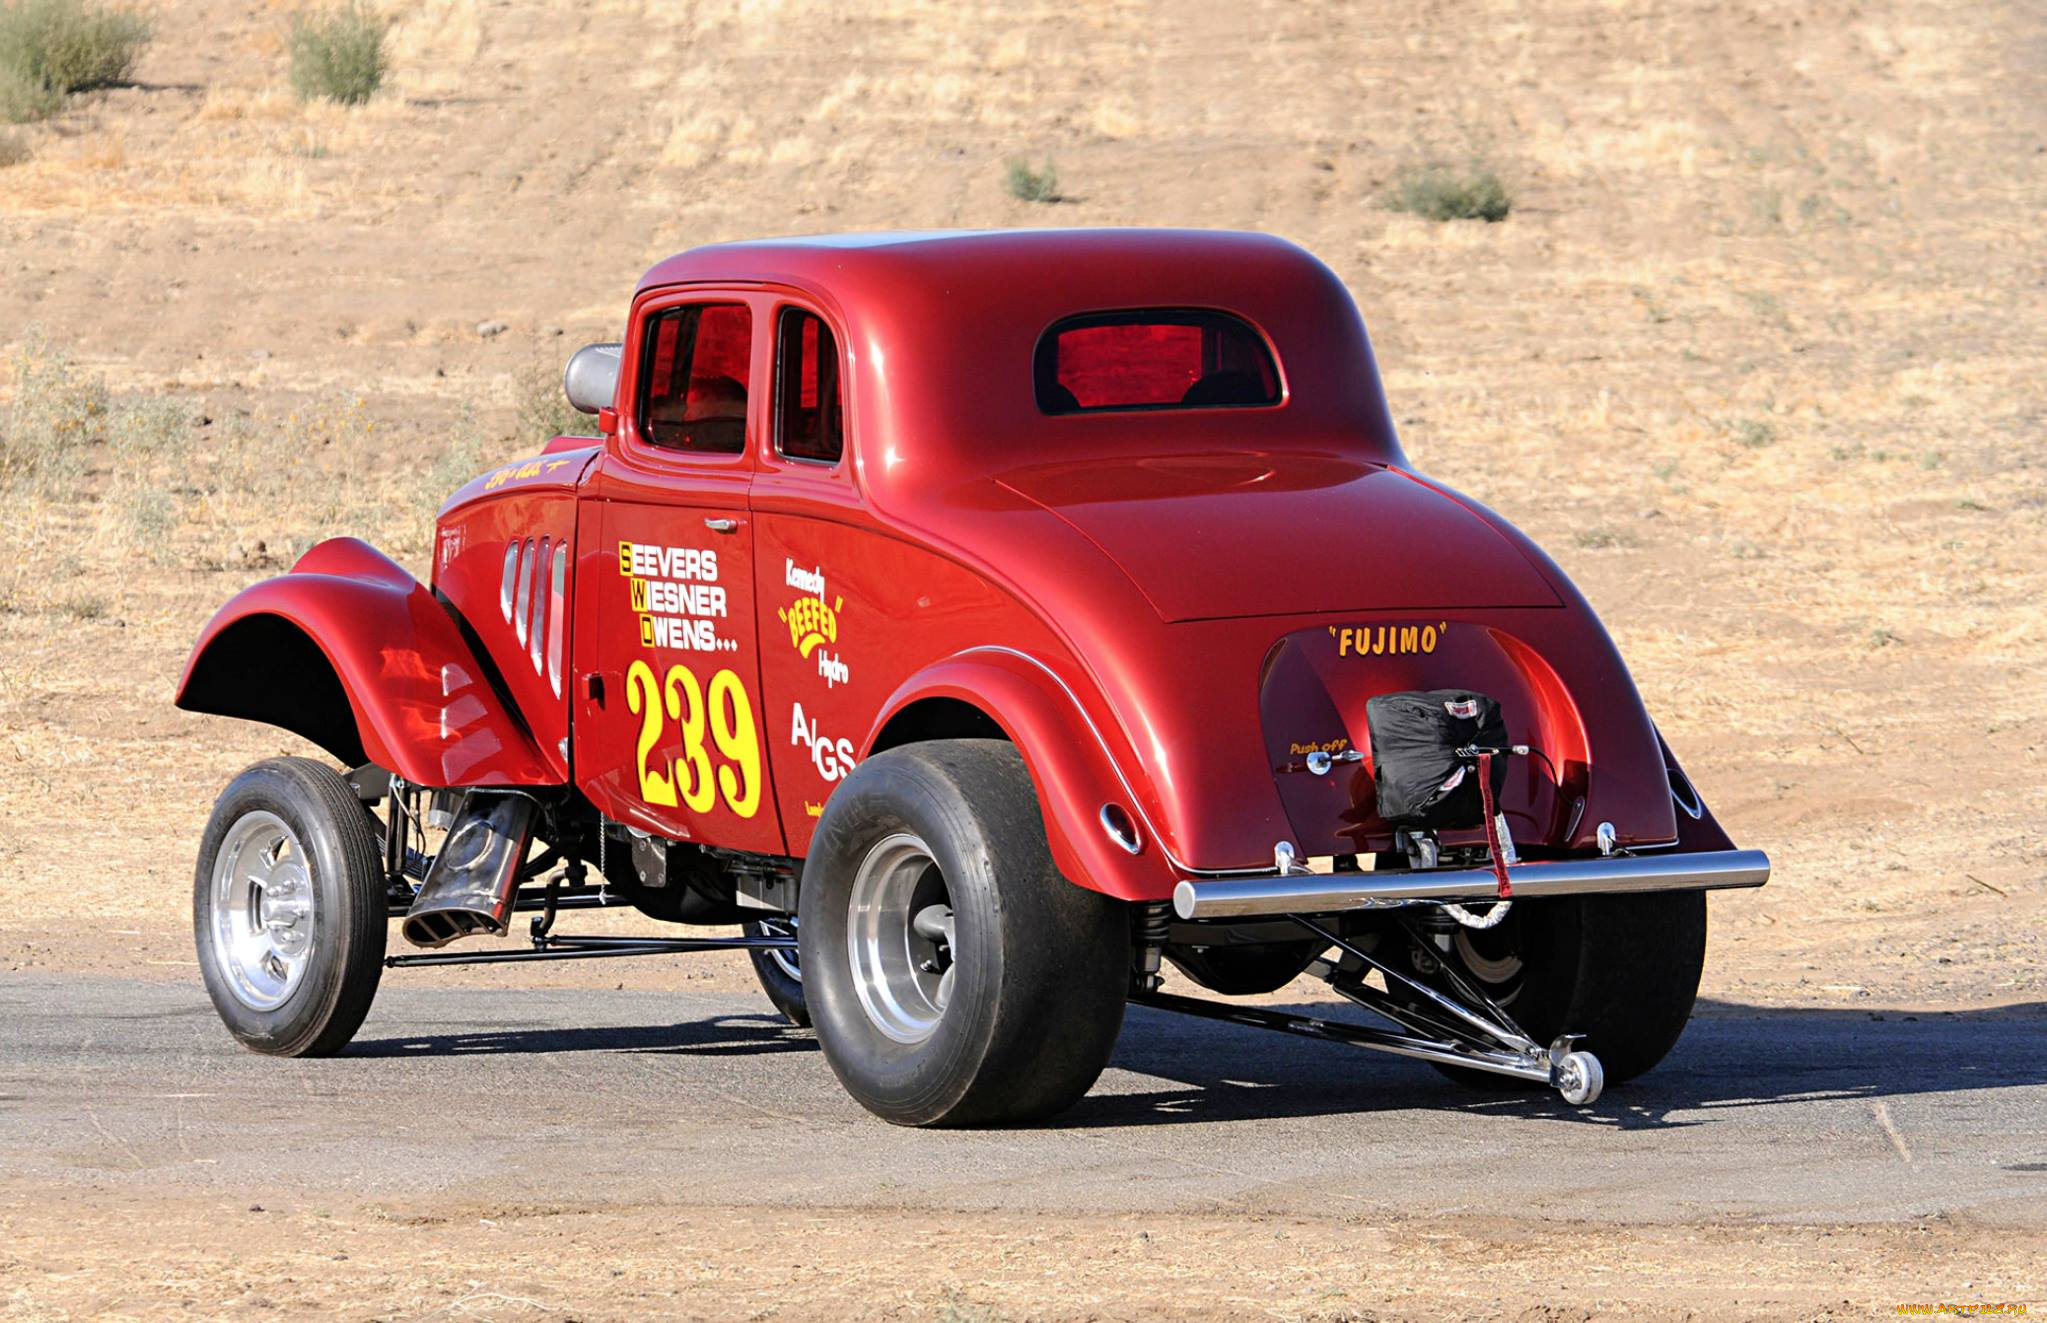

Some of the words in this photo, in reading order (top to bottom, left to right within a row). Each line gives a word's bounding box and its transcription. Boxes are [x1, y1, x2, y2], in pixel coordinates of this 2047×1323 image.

[619, 541, 718, 581] SEEVERS
[631, 578, 727, 617] WIESNER
[1328, 621, 1447, 657] "FUJIMO"
[818, 648, 849, 688] Hydro
[626, 660, 762, 818] 239
[1290, 741, 1319, 755] Push
[1321, 738, 1348, 752] off
